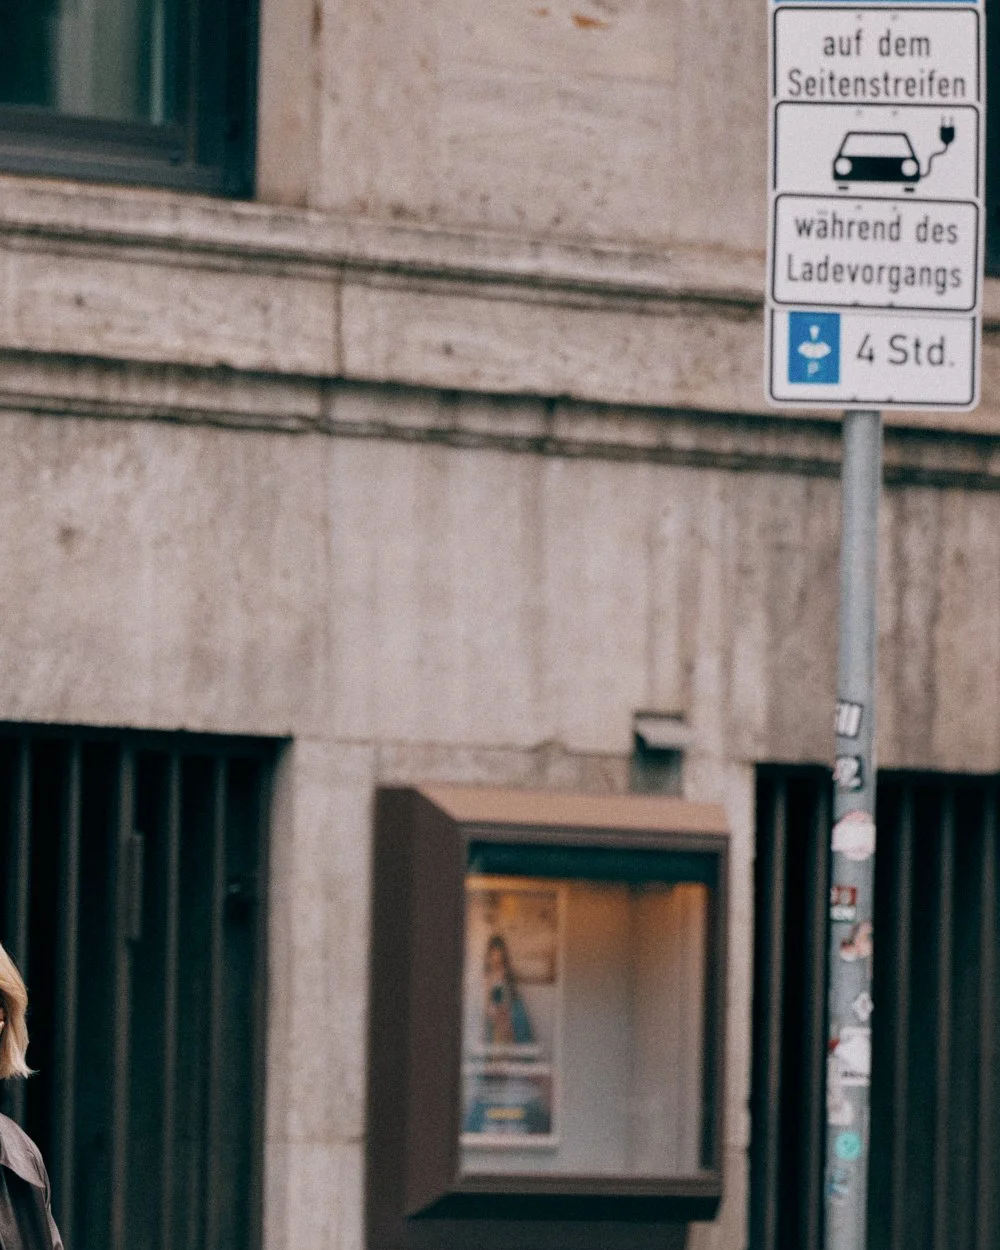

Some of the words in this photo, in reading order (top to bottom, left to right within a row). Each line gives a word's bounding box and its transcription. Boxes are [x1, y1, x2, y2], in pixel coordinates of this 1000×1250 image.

[822, 28, 863, 57] auf
[878, 29, 931, 57] dem
[788, 67, 967, 98] Seitenstreifen
[795, 208, 902, 242] während
[915, 215, 959, 244] des
[787, 253, 962, 295] Ladevorgangs
[856, 334, 875, 368] 4
[888, 334, 955, 367] Std.
